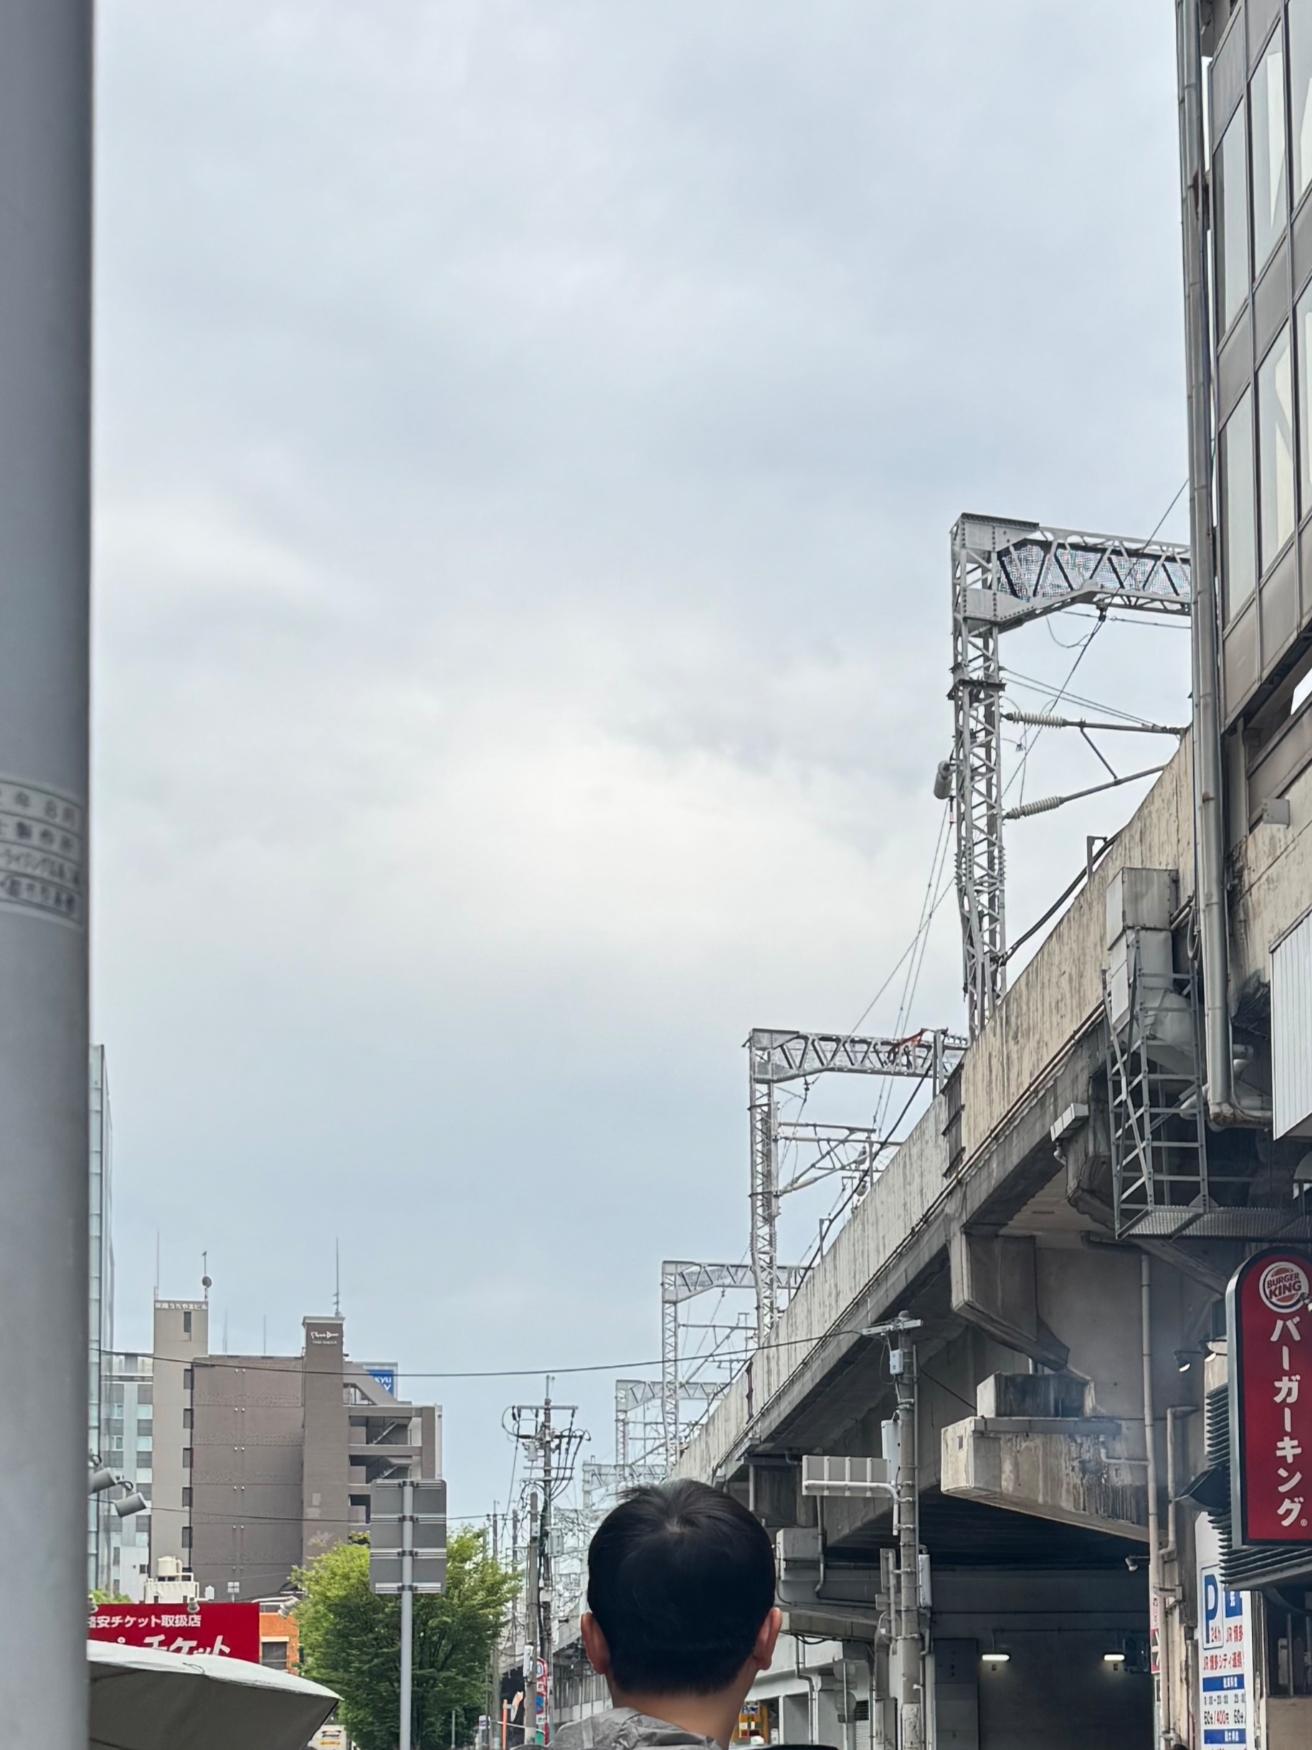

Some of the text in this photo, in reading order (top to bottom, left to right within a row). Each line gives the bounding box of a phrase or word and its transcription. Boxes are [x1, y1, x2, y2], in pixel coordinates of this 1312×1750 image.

[1266, 1272, 1300, 1289] BURGER
[1268, 1281, 1302, 1301] KING
[1269, 1316, 1304, 1527] バーガーキング
